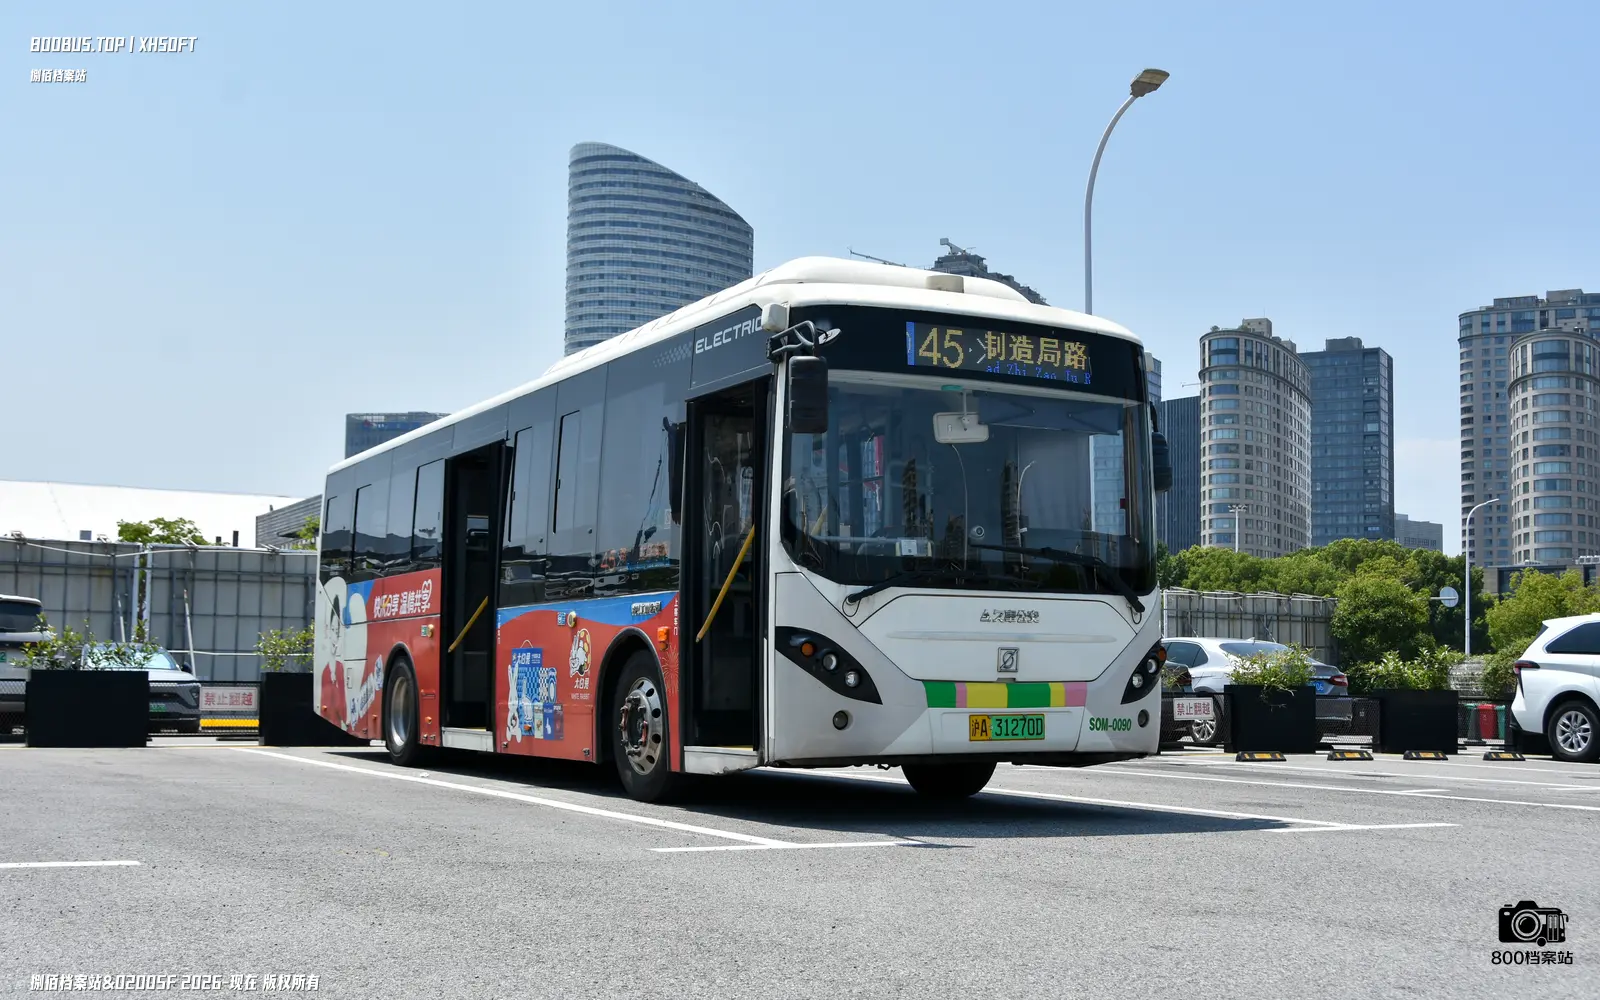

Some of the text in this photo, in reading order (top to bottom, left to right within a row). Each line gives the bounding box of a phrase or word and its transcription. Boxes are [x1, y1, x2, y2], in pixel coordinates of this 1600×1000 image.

[918, 327, 964, 369] 45
[984, 330, 1087, 370] 制造局路
[204, 692, 253, 706] 禁止翻越
[1177, 702, 1210, 716] 禁止翻越
